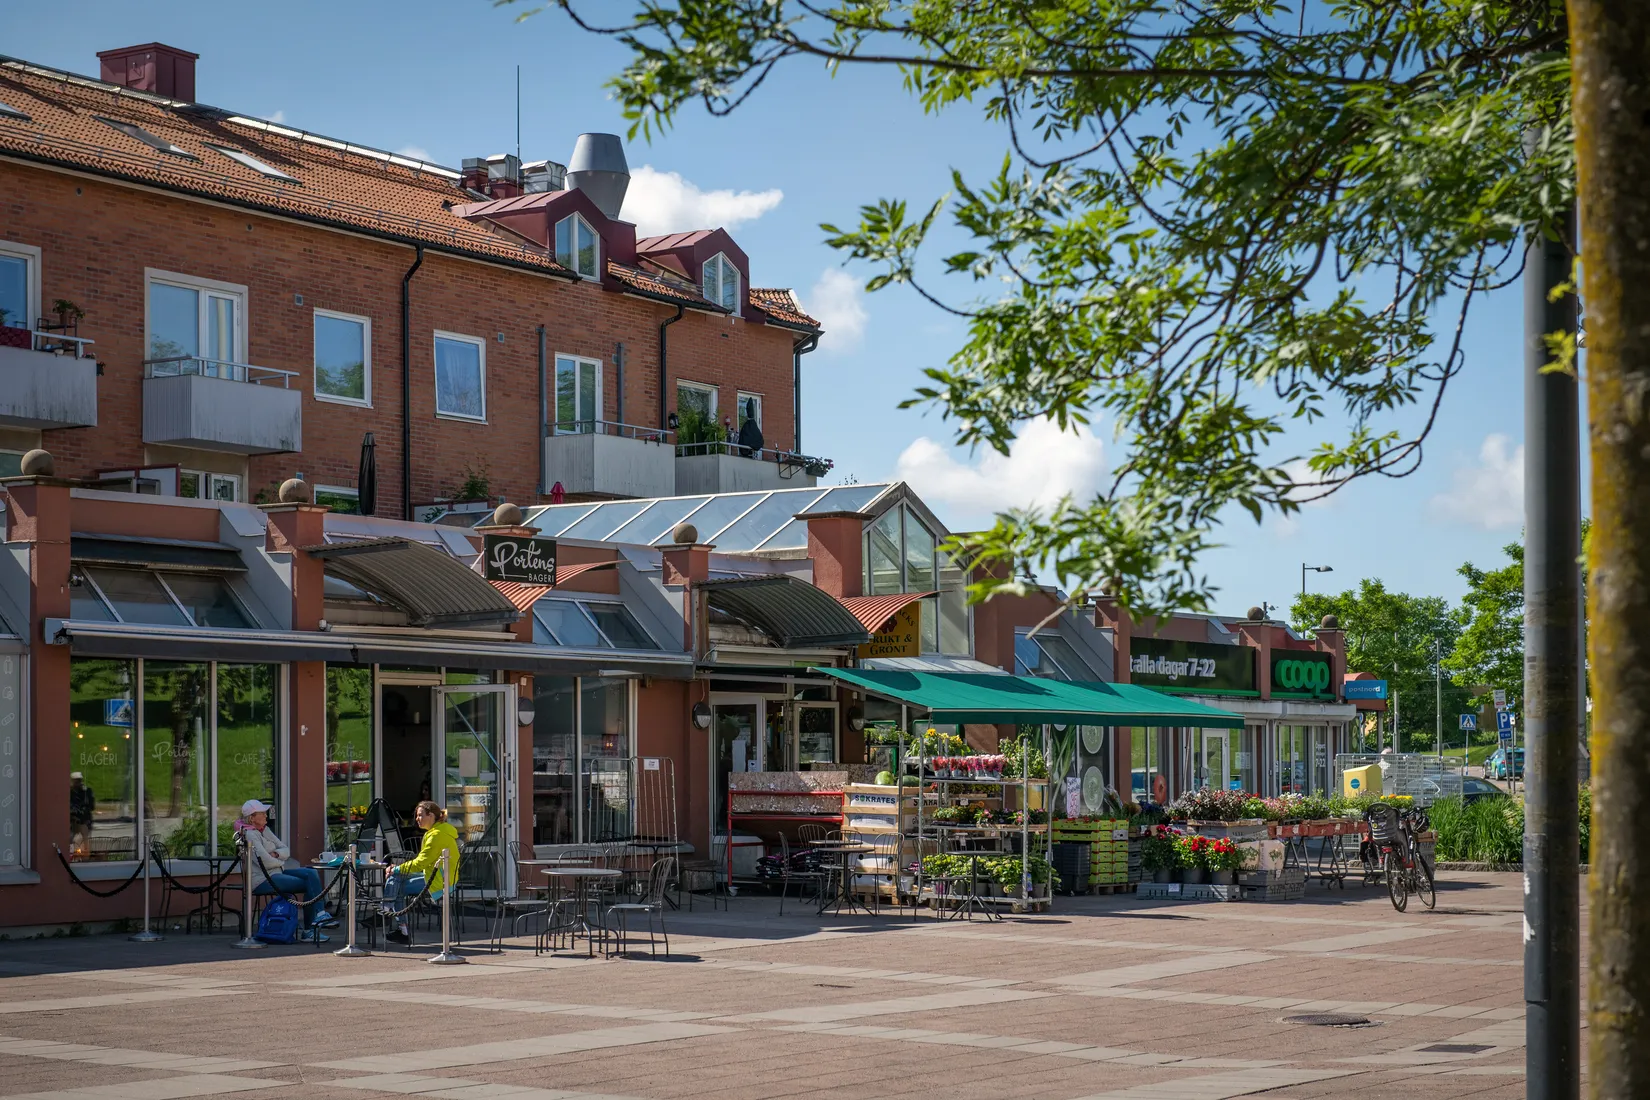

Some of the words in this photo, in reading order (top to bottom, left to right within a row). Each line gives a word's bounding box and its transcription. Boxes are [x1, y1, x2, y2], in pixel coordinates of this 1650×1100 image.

[490, 540, 555, 580] Portens
[528, 573, 554, 583] BAGERI
[873, 635, 901, 644] RUKT
[903, 634, 912, 643] &
[1133, 654, 1156, 675] alla
[1156, 655, 1188, 680] dagar
[1188, 657, 1216, 678] 7-22
[1276, 659, 1330, 697] coop
[1348, 685, 1381, 693] postnord
[1500, 713, 1508, 729] P
[80, 752, 118, 766] BAGERI
[151, 740, 199, 766] Portens
[854, 794, 896, 804] SOKRATES
